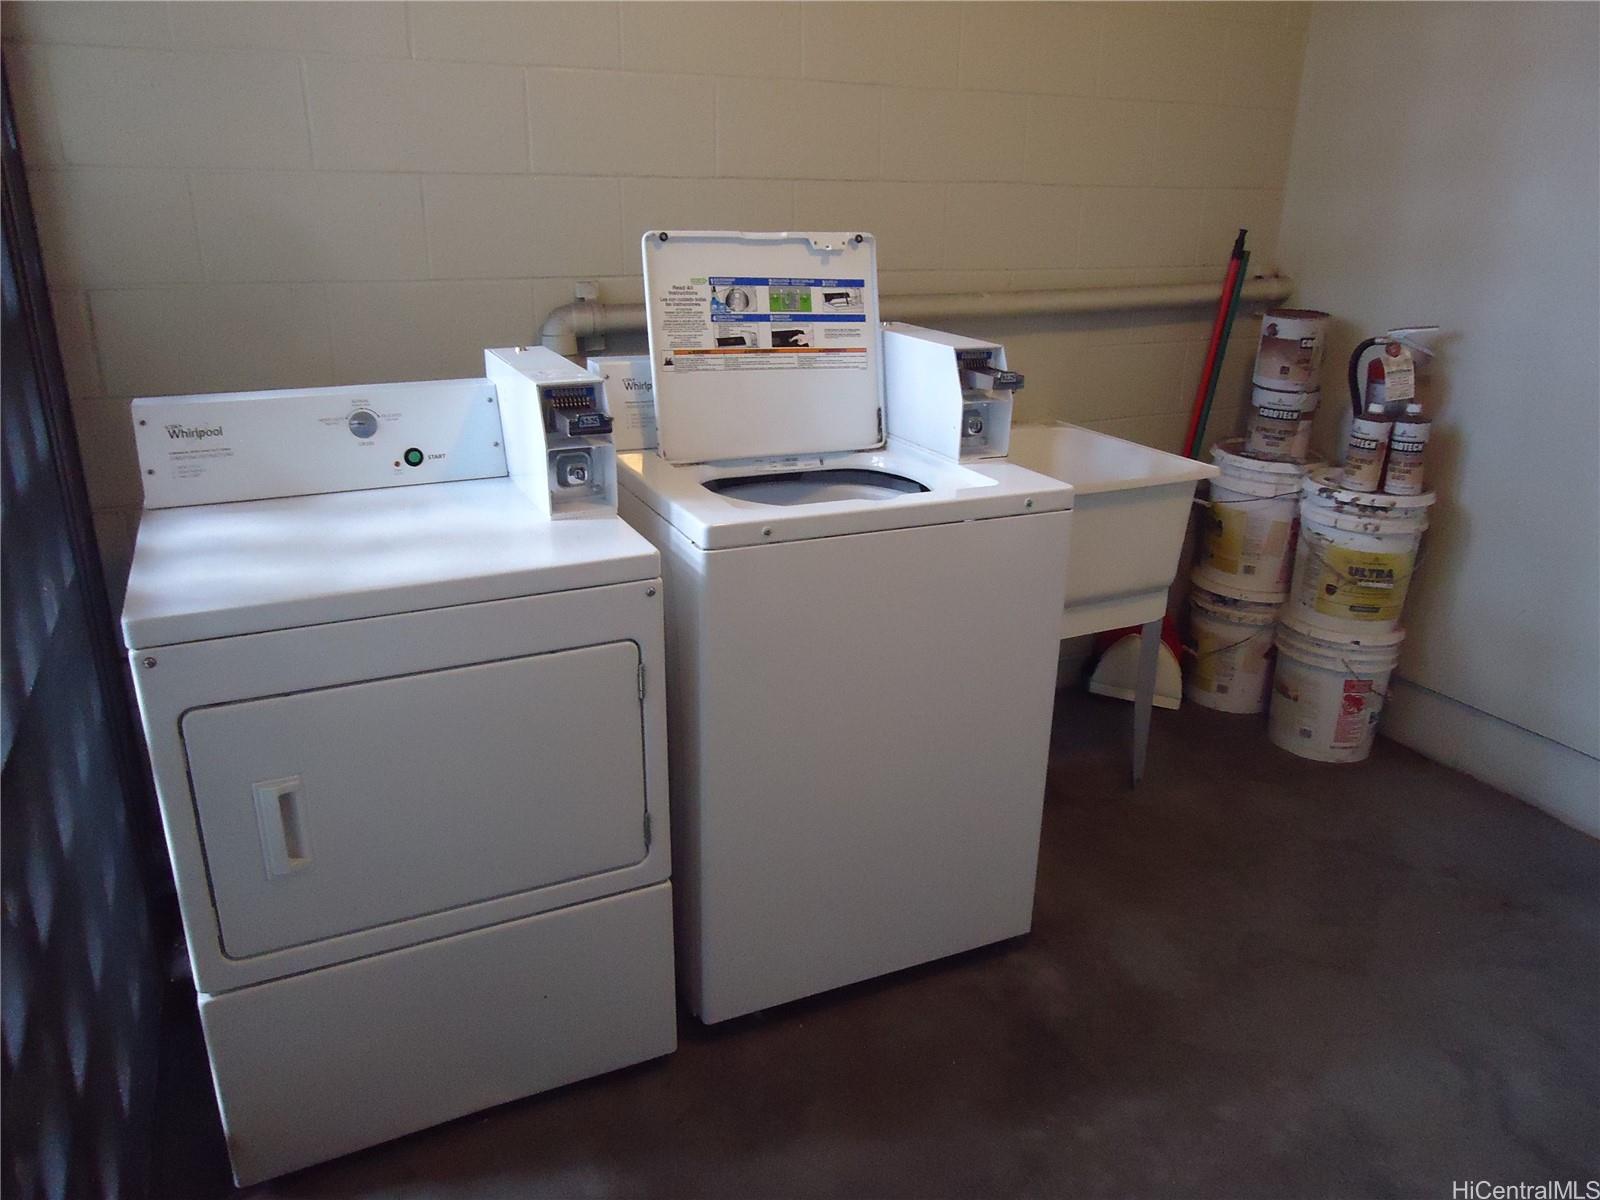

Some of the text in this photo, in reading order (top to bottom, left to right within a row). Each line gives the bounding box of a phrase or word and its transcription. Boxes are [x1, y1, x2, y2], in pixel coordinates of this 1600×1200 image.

[1259, 407, 1299, 420] COROTECH
[168, 425, 223, 440] Whirlpool
[1348, 566, 1393, 579] ULTRA
